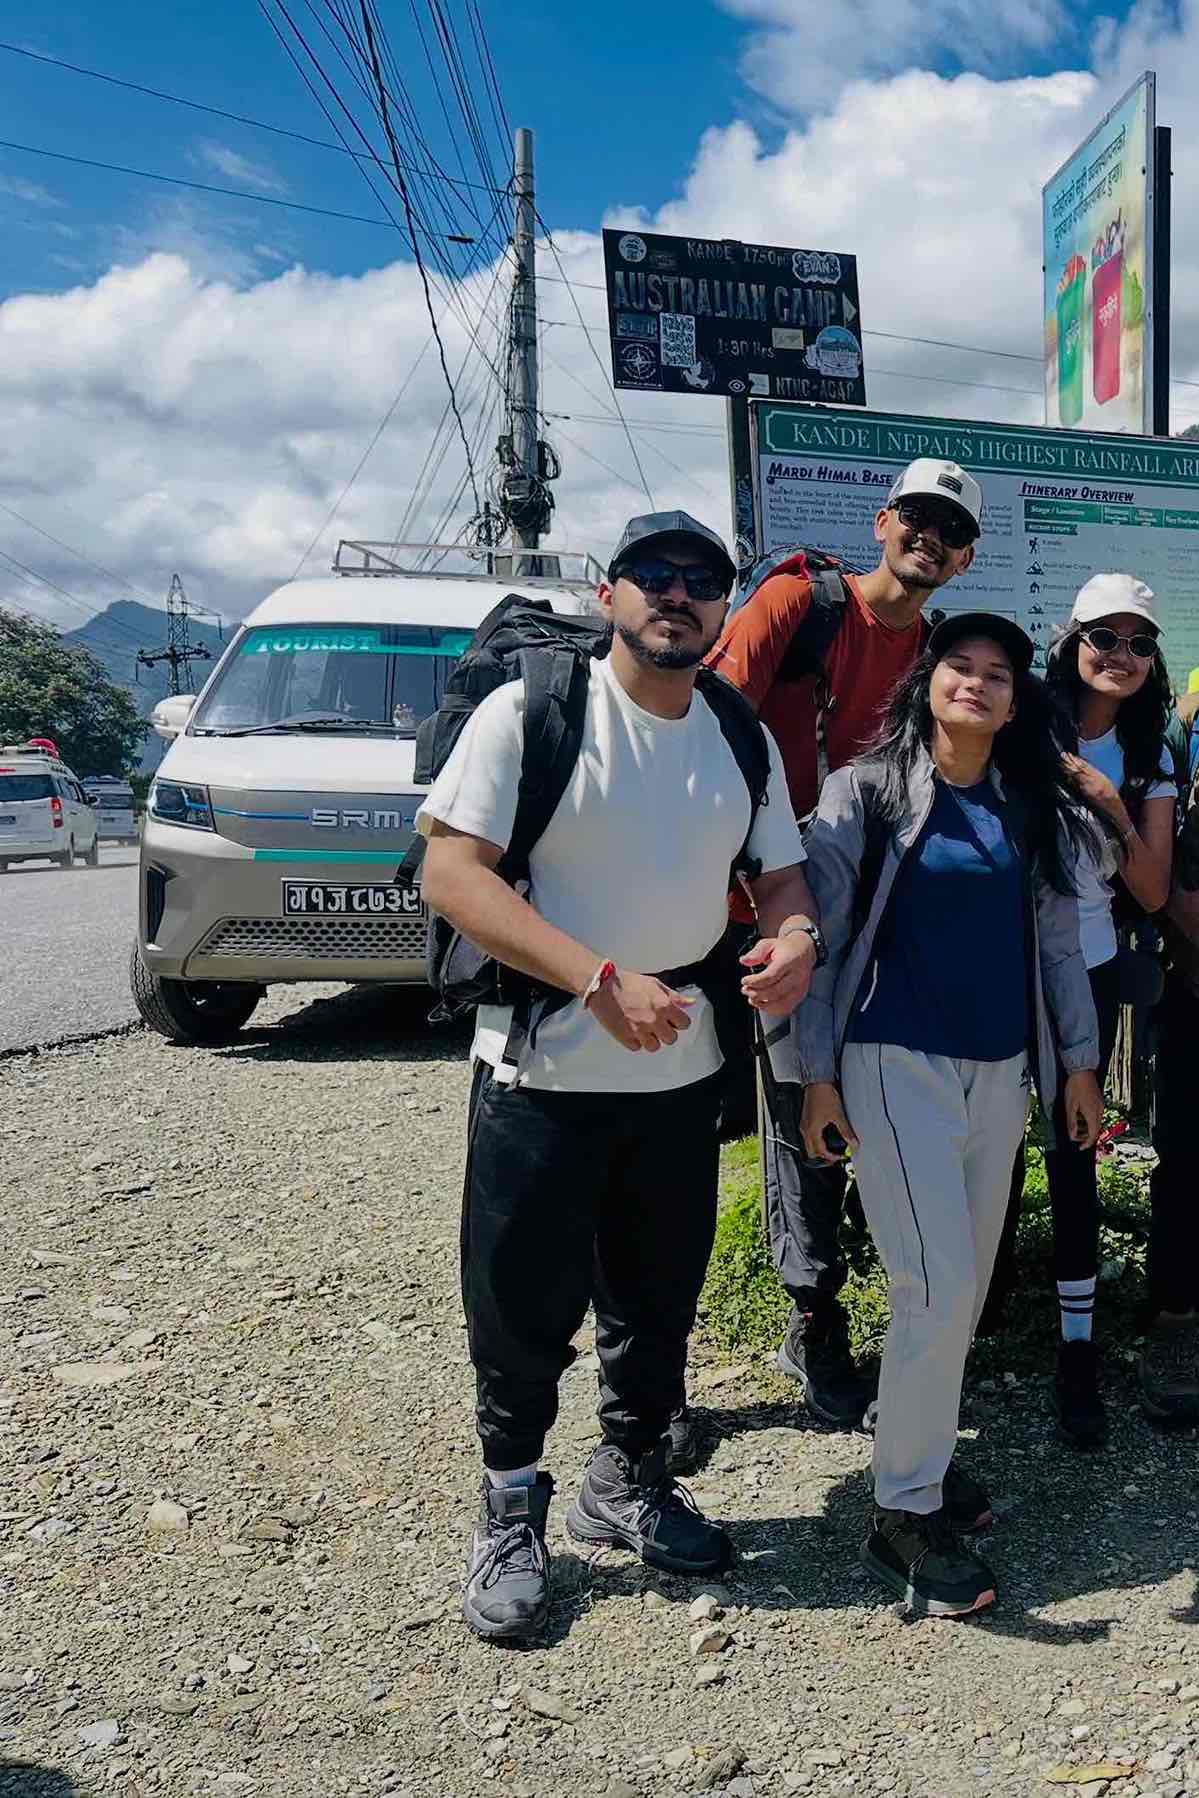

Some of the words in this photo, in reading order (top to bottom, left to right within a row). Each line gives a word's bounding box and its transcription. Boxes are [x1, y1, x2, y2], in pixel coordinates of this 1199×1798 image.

[613, 270, 768, 322] AUSTRALIAN
[773, 285, 837, 327] CAMP
[792, 423, 871, 449] KANDE
[887, 431, 973, 458] NEPAL'S
[979, 440, 1071, 467] HIGHEST
[1073, 449, 1167, 475] RAINFALL
[769, 462, 813, 479] MARDI
[817, 466, 858, 482] HIMAL
[862, 470, 894, 485] BASE
[1022, 481, 1078, 498] ITINERARY
[1080, 485, 1135, 502] OVERVIEW
[256, 635, 374, 653] TOURIST
[311, 808, 401, 828] SRM
